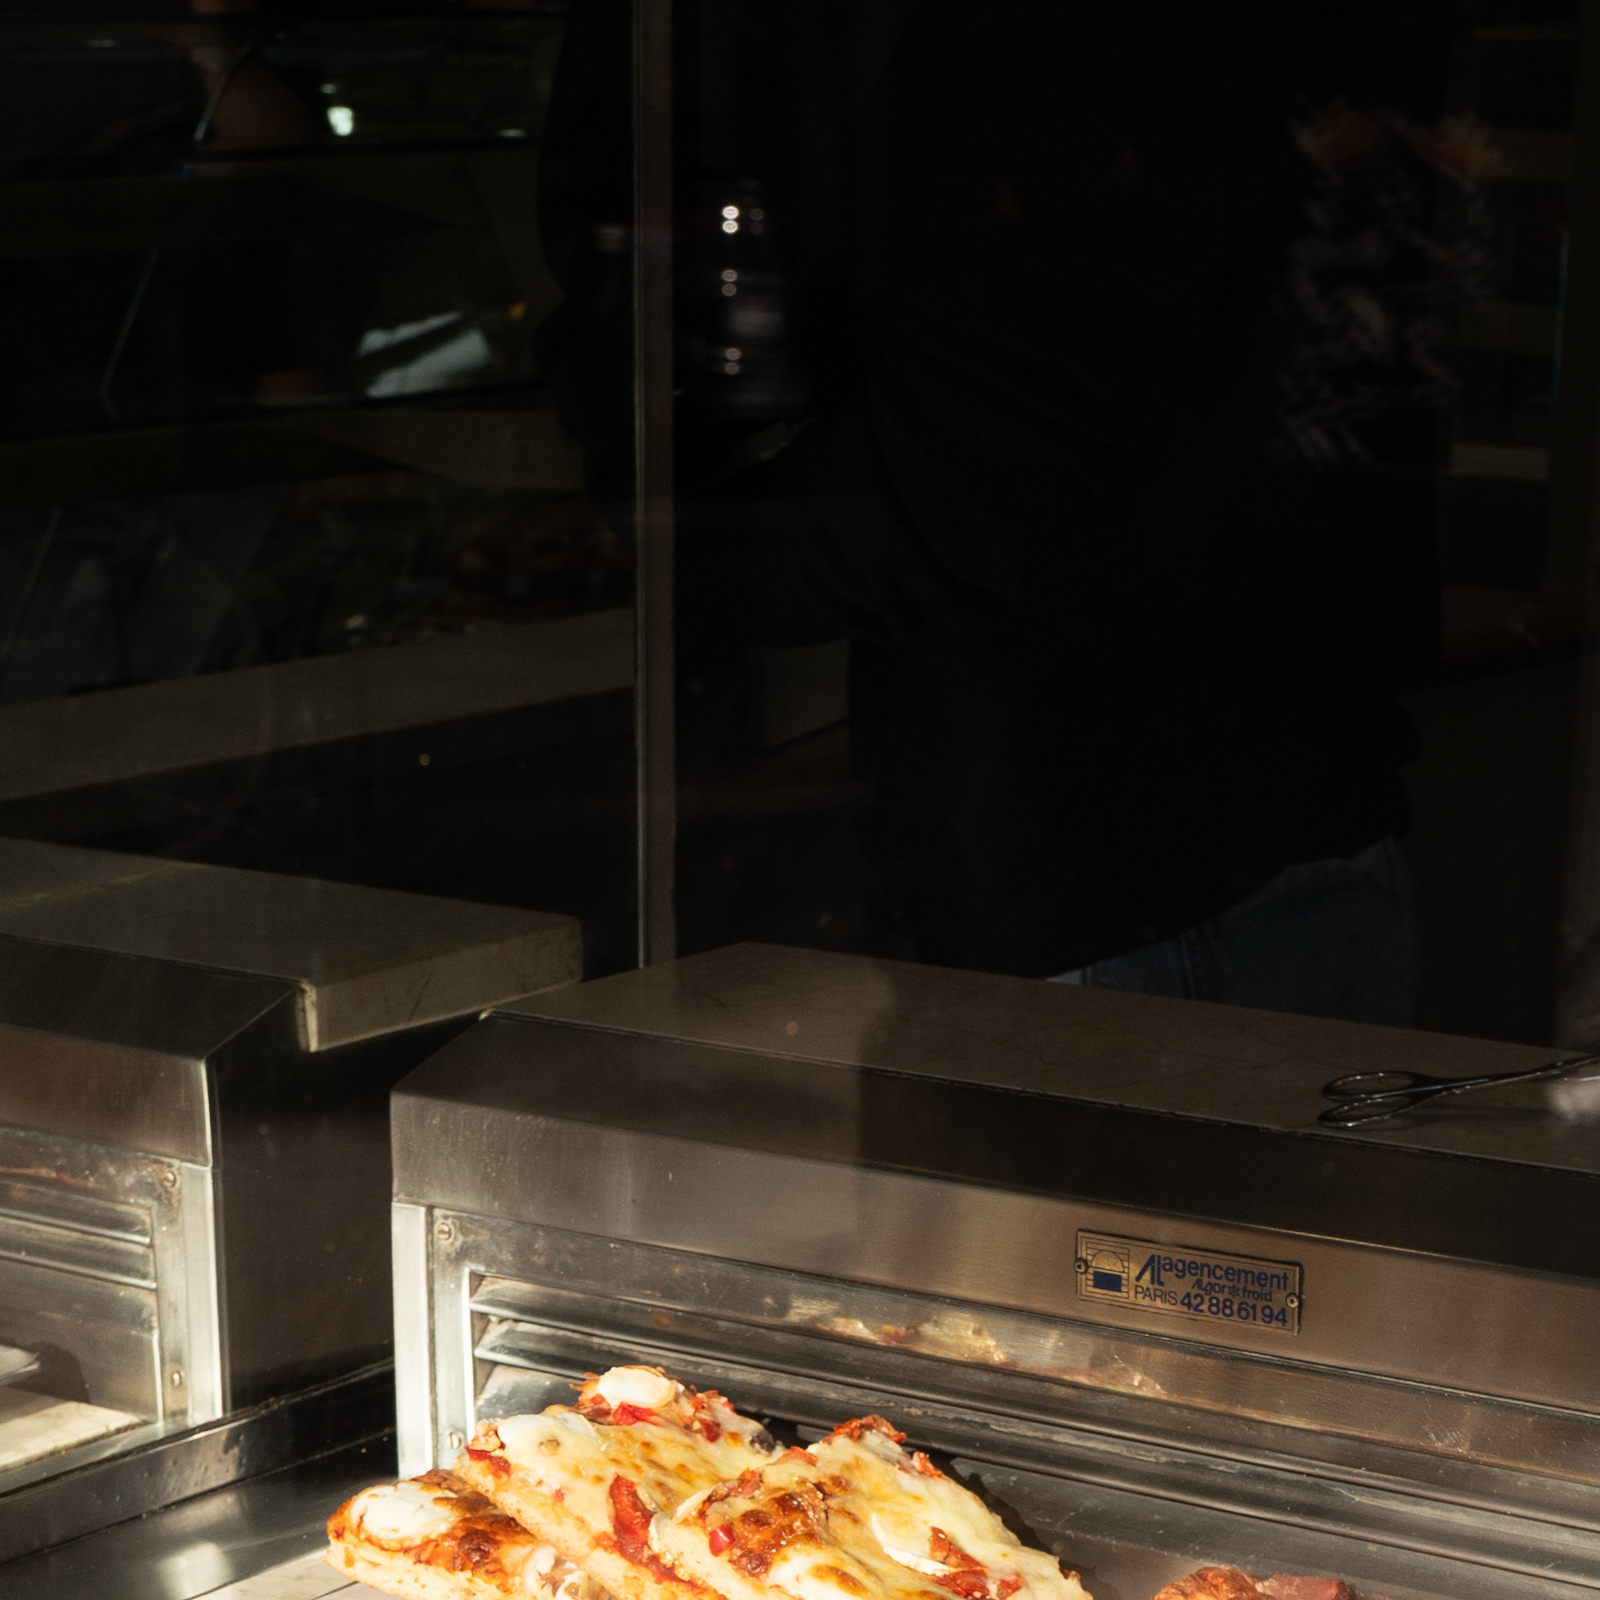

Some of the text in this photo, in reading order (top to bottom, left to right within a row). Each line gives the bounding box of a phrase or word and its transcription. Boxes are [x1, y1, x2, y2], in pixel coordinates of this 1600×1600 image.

[1162, 1256, 1289, 1291] agencement
[1135, 1284, 1178, 1306] PARIS
[1242, 1285, 1273, 1303] froid
